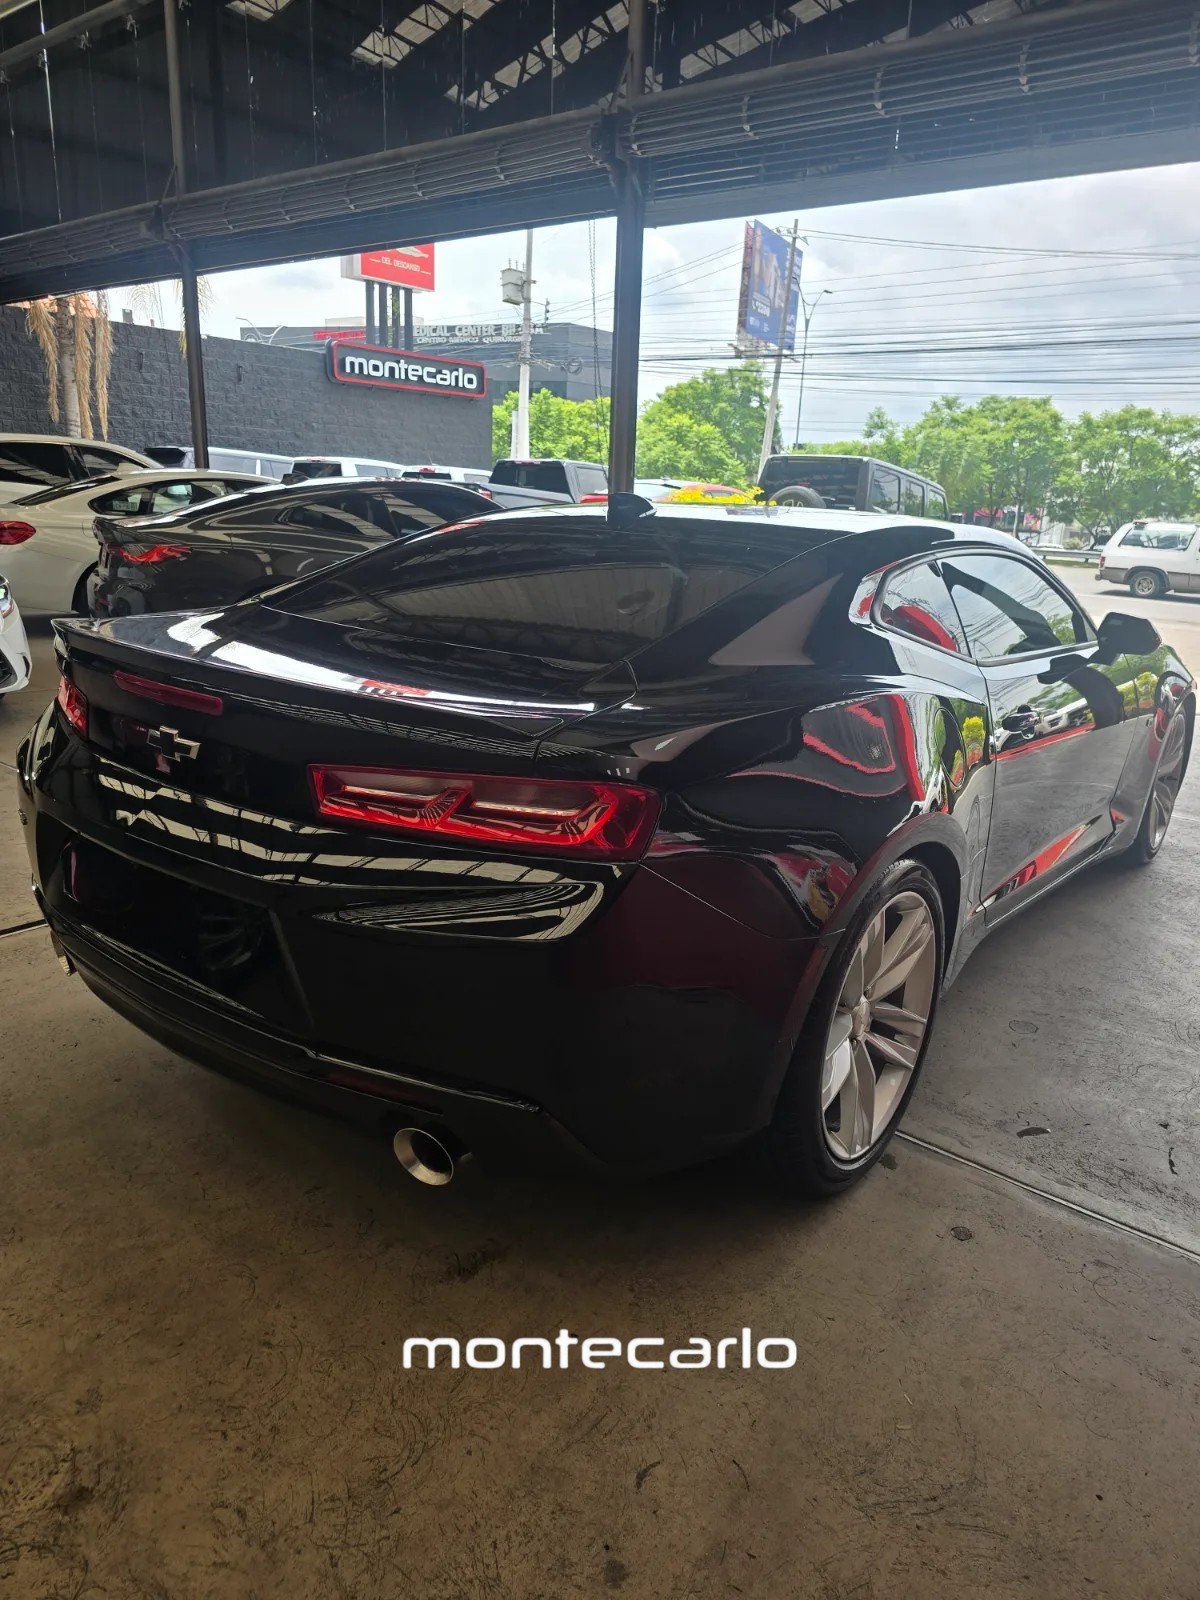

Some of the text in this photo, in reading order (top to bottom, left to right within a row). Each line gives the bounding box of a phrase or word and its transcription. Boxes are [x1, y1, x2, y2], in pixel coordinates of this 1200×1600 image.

[381, 256, 392, 266] DEL
[413, 324, 449, 336] EDICAL
[455, 324, 496, 336] CENTER
[345, 356, 477, 389] montecarlo
